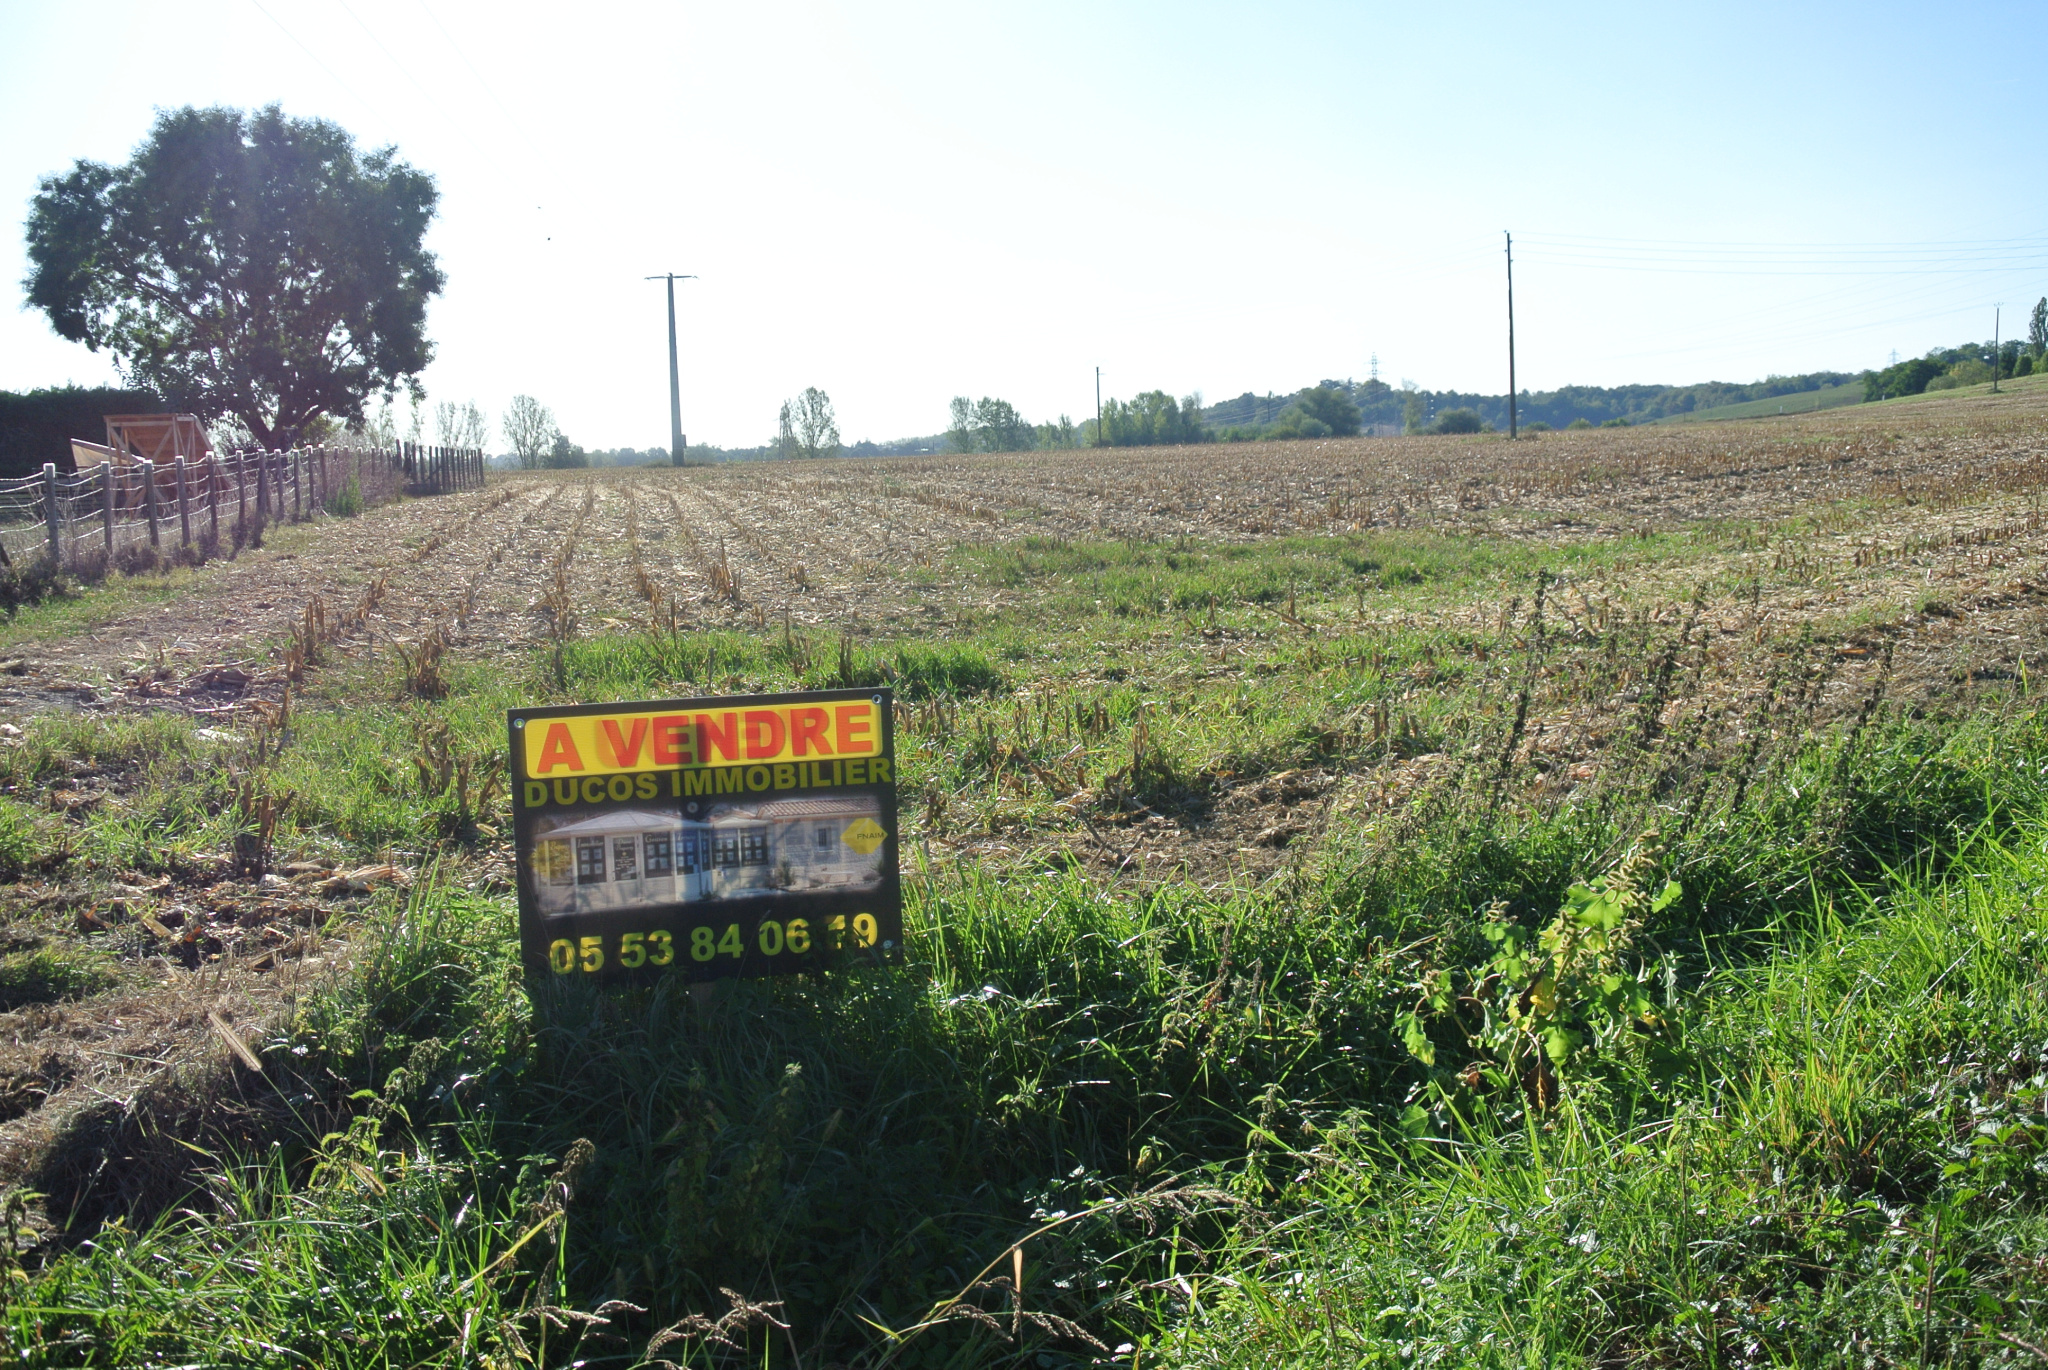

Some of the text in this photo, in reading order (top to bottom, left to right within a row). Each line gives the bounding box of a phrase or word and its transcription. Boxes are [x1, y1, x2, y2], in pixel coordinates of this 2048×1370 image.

[537, 705, 873, 773] A VENDRE
[524, 758, 892, 807] DUCOS IMMOBILIER
[550, 936, 604, 974] 05
[621, 930, 674, 968] 53
[691, 924, 744, 961] 84
[759, 918, 811, 956] 06
